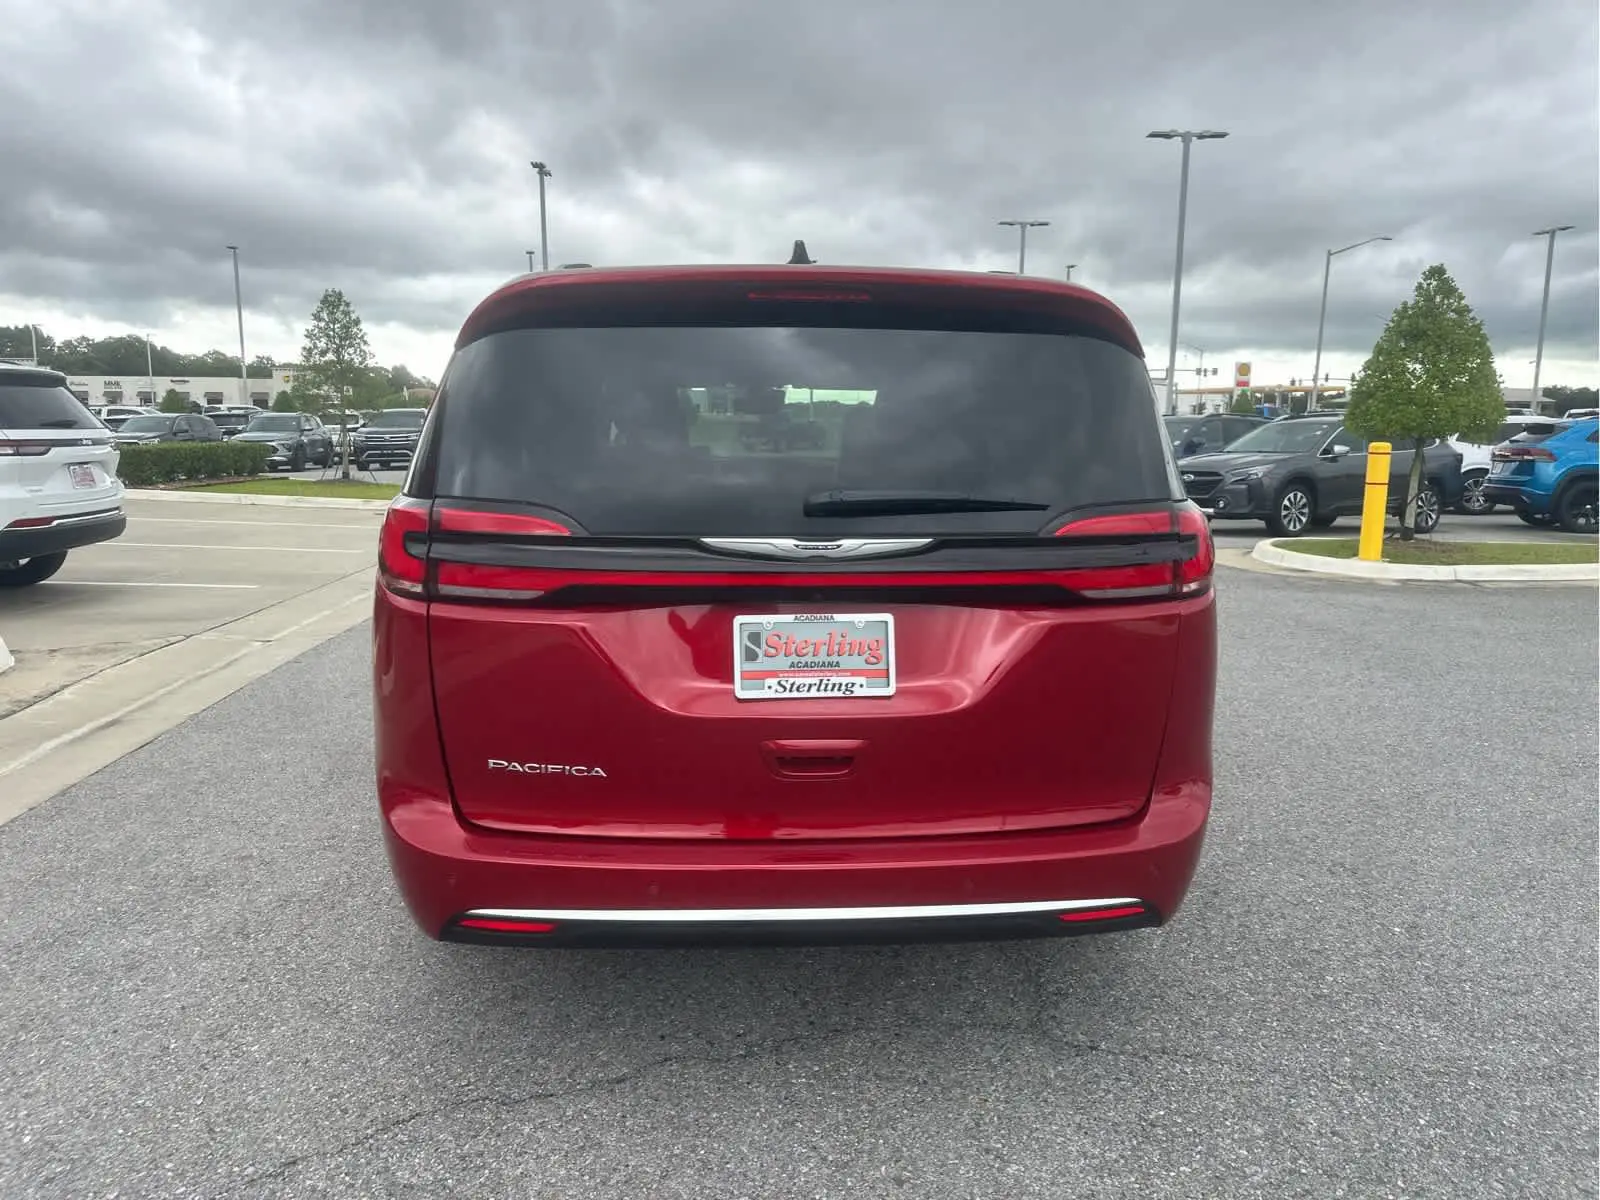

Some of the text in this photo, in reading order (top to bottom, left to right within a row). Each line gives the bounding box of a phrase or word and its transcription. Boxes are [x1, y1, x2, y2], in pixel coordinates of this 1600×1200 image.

[764, 629, 883, 665] Sterling
[789, 660, 841, 669] ACADIANA
[774, 679, 857, 695] Sterling
[487, 759, 607, 777] PACIFICA
